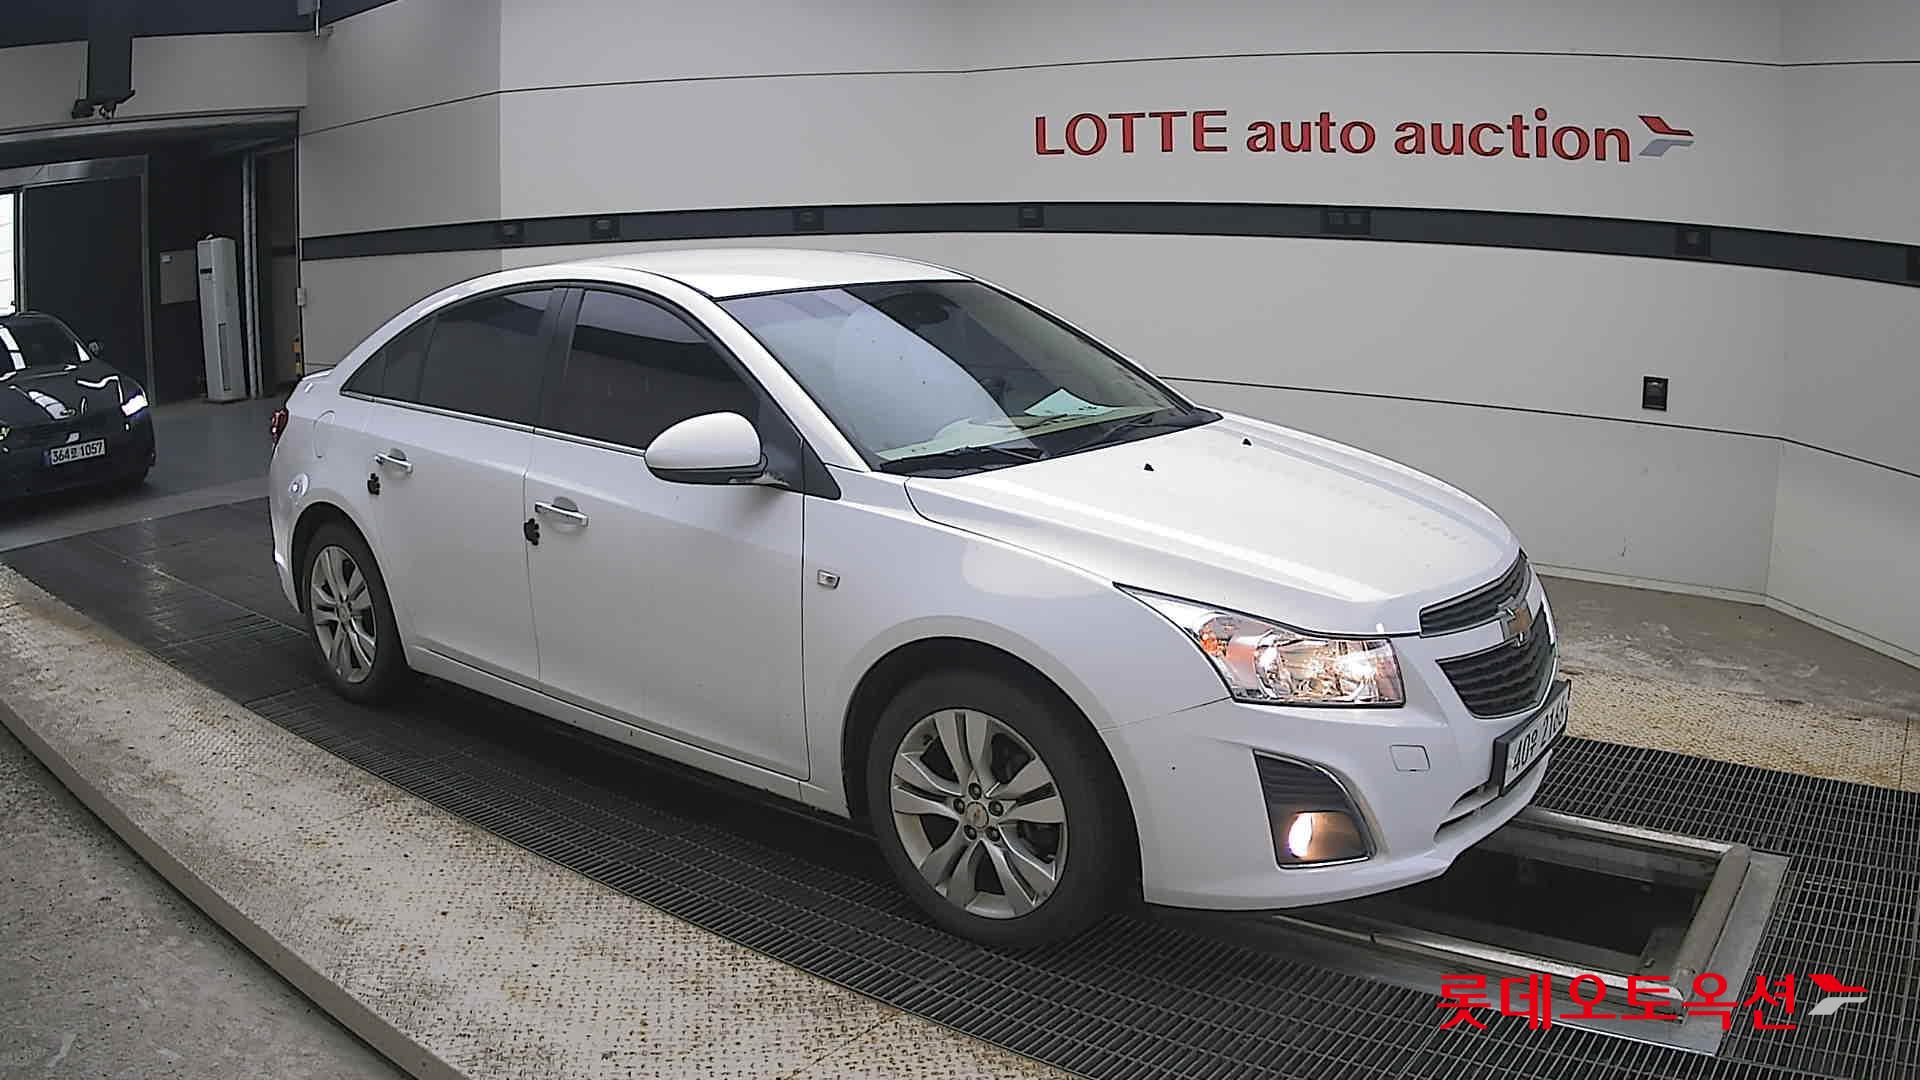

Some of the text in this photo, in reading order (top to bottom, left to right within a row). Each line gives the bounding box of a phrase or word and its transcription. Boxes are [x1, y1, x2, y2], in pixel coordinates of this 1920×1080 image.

[1035, 107, 1630, 163] LOTTE auto auction
[80, 441, 103, 457] 1057
